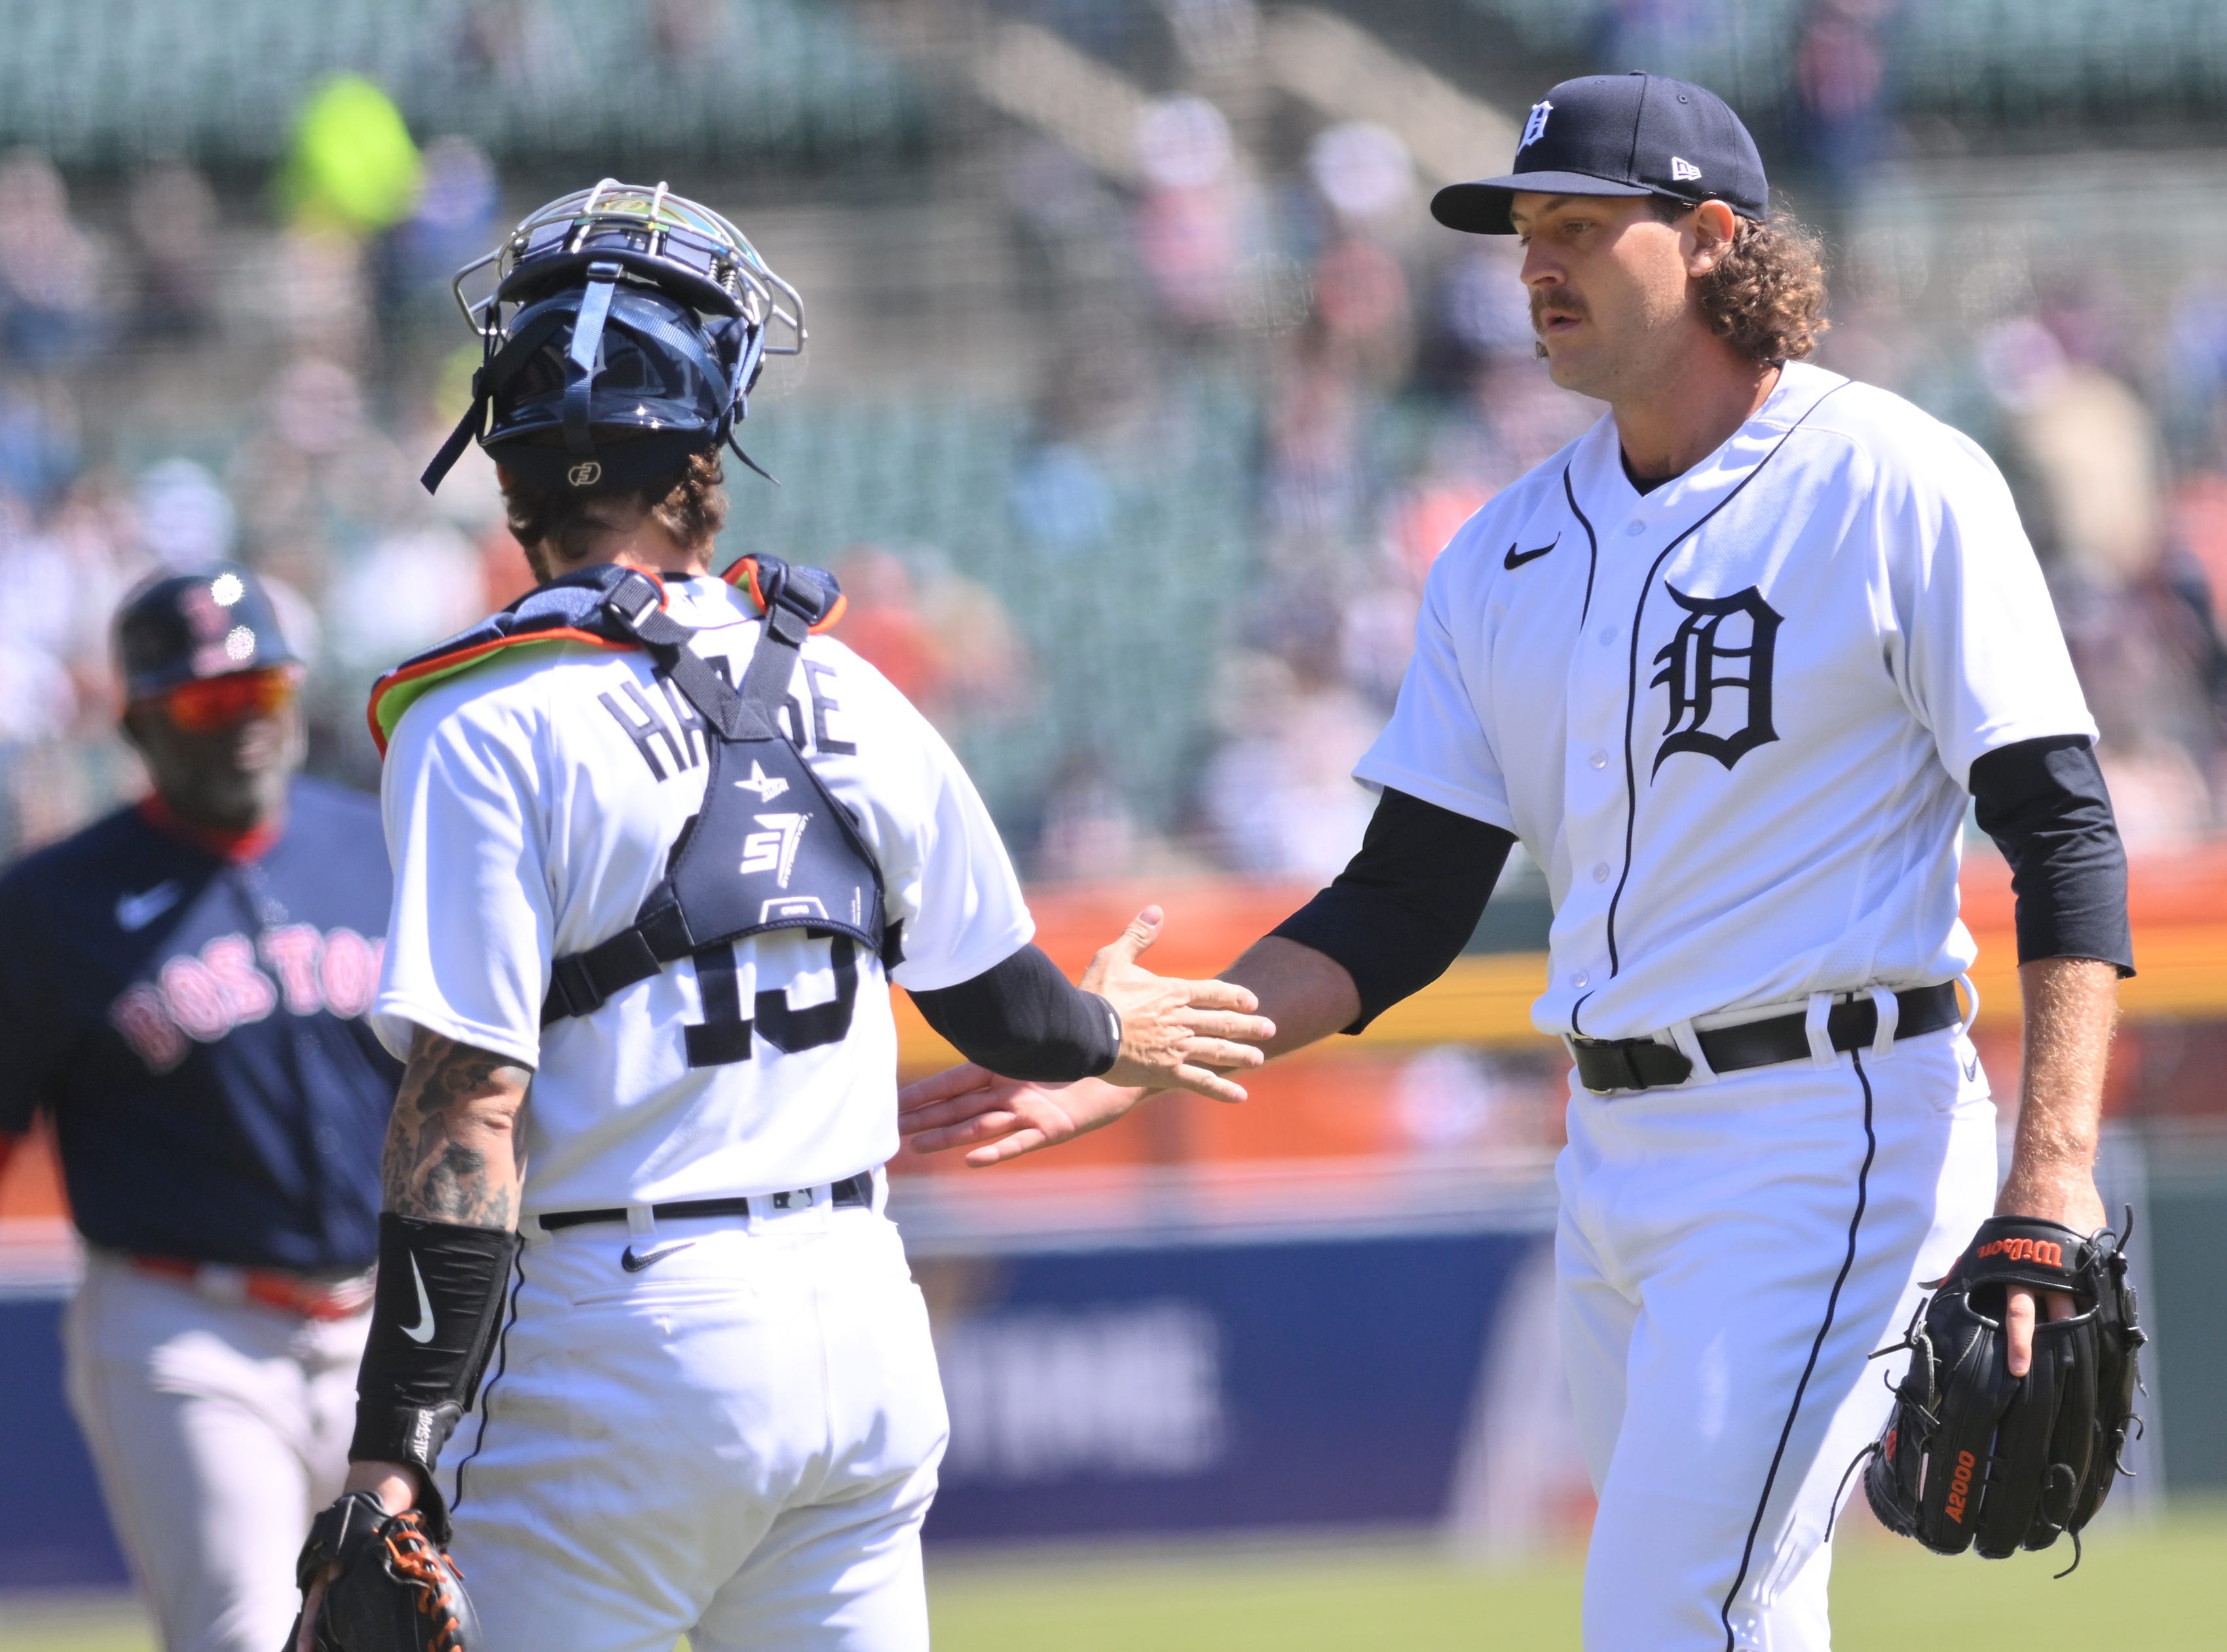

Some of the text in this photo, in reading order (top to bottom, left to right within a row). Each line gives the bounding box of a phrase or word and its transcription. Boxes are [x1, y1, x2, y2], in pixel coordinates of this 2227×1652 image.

[1517, 100, 1554, 156] D
[1651, 580, 1785, 787] D
[1977, 1238, 2063, 1267] Wilson
[1944, 1450, 1975, 1524] A2000
